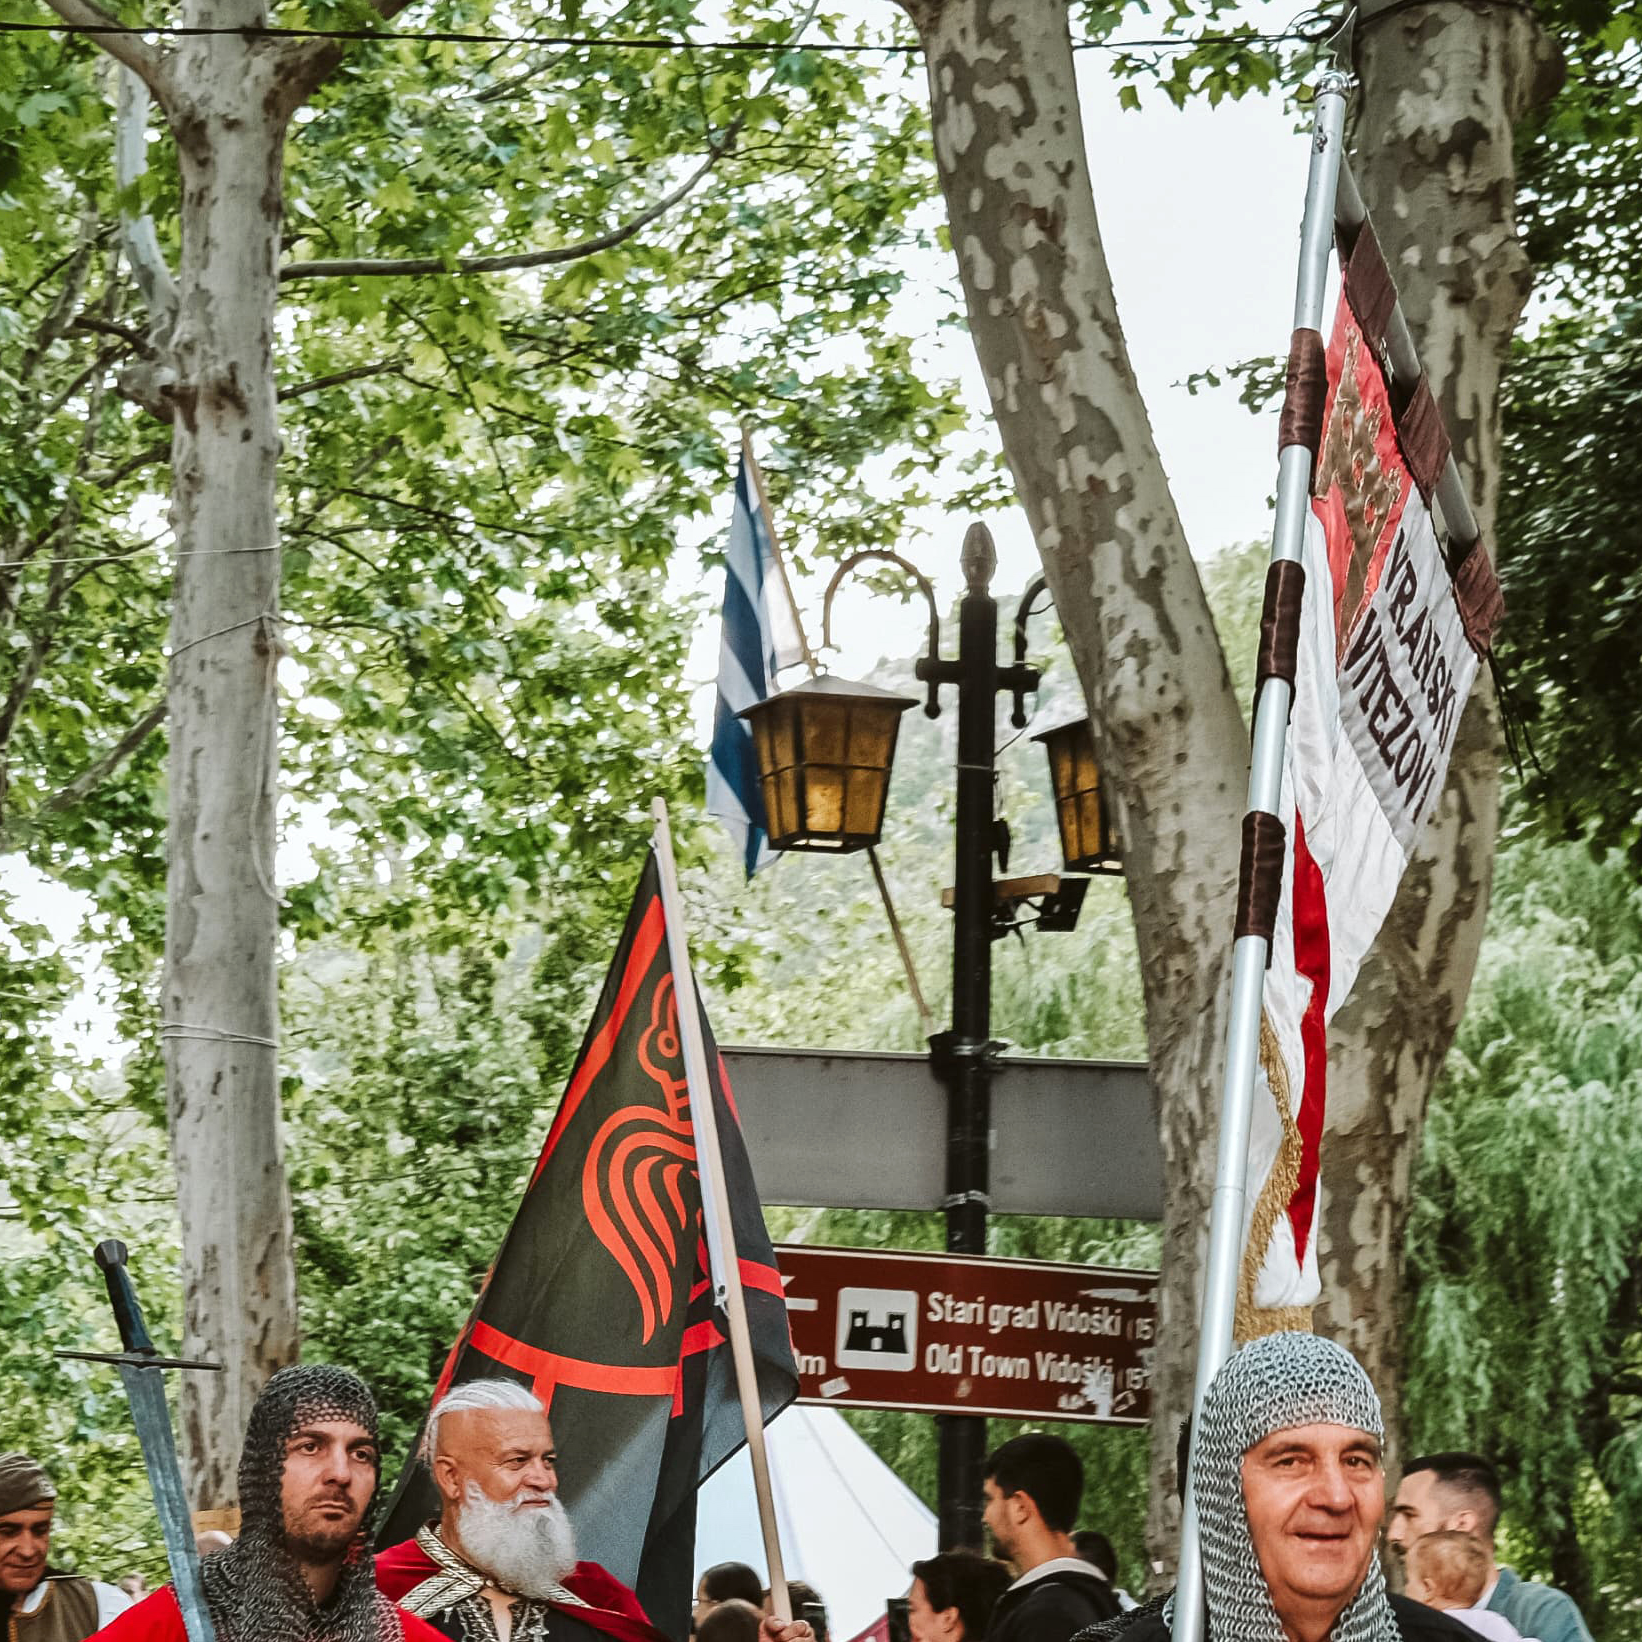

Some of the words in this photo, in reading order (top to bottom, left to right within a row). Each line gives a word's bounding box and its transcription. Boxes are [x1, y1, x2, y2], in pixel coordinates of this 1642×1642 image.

[1385, 526, 1457, 754] VRANSKI
[1343, 607, 1436, 824] VITEZOVI
[925, 1343, 964, 1375] Old
[967, 1346, 1030, 1380] Town
[927, 1291, 986, 1325] Stari
[988, 1300, 1040, 1335] grad
[1044, 1300, 1123, 1337] Vidoški
